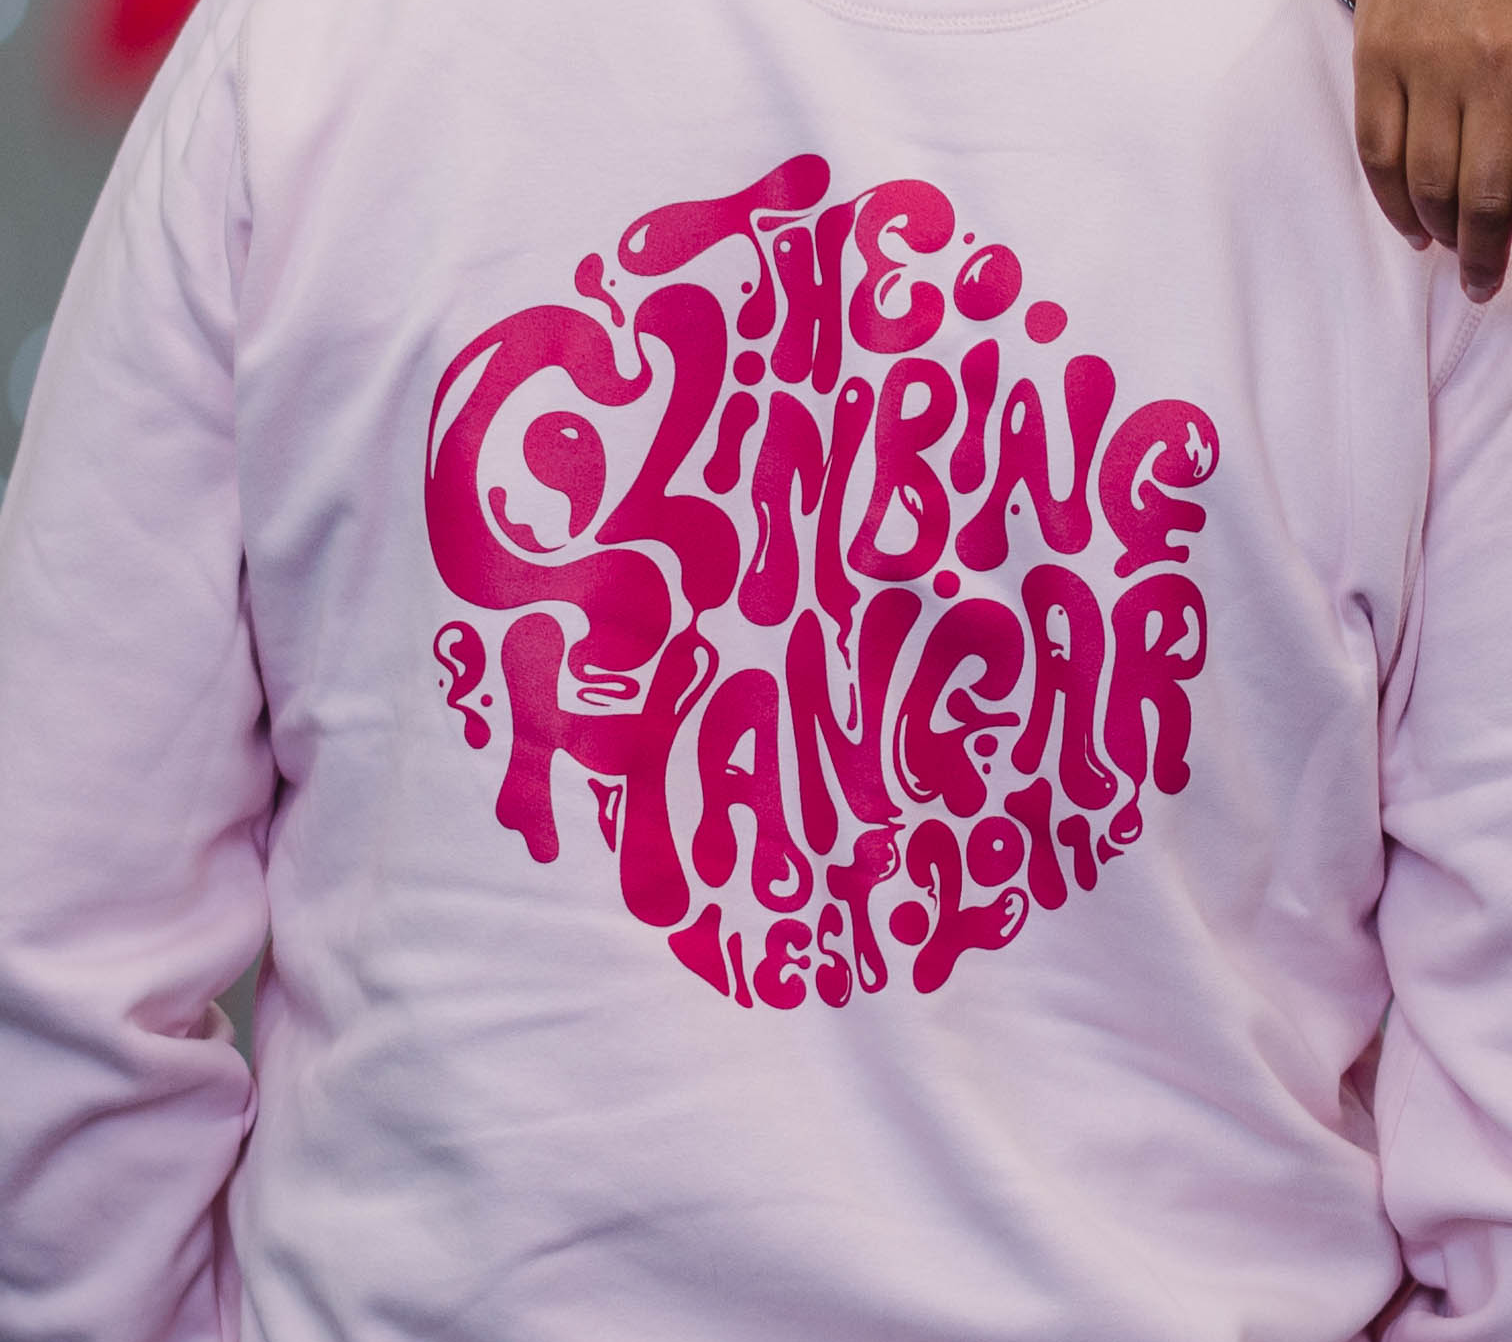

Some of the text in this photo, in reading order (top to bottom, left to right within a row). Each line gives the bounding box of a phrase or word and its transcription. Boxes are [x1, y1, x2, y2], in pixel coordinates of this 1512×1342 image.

[618, 153, 956, 396] THE
[424, 283, 1221, 671] CLIMBING
[495, 564, 1208, 928] HANGAR
